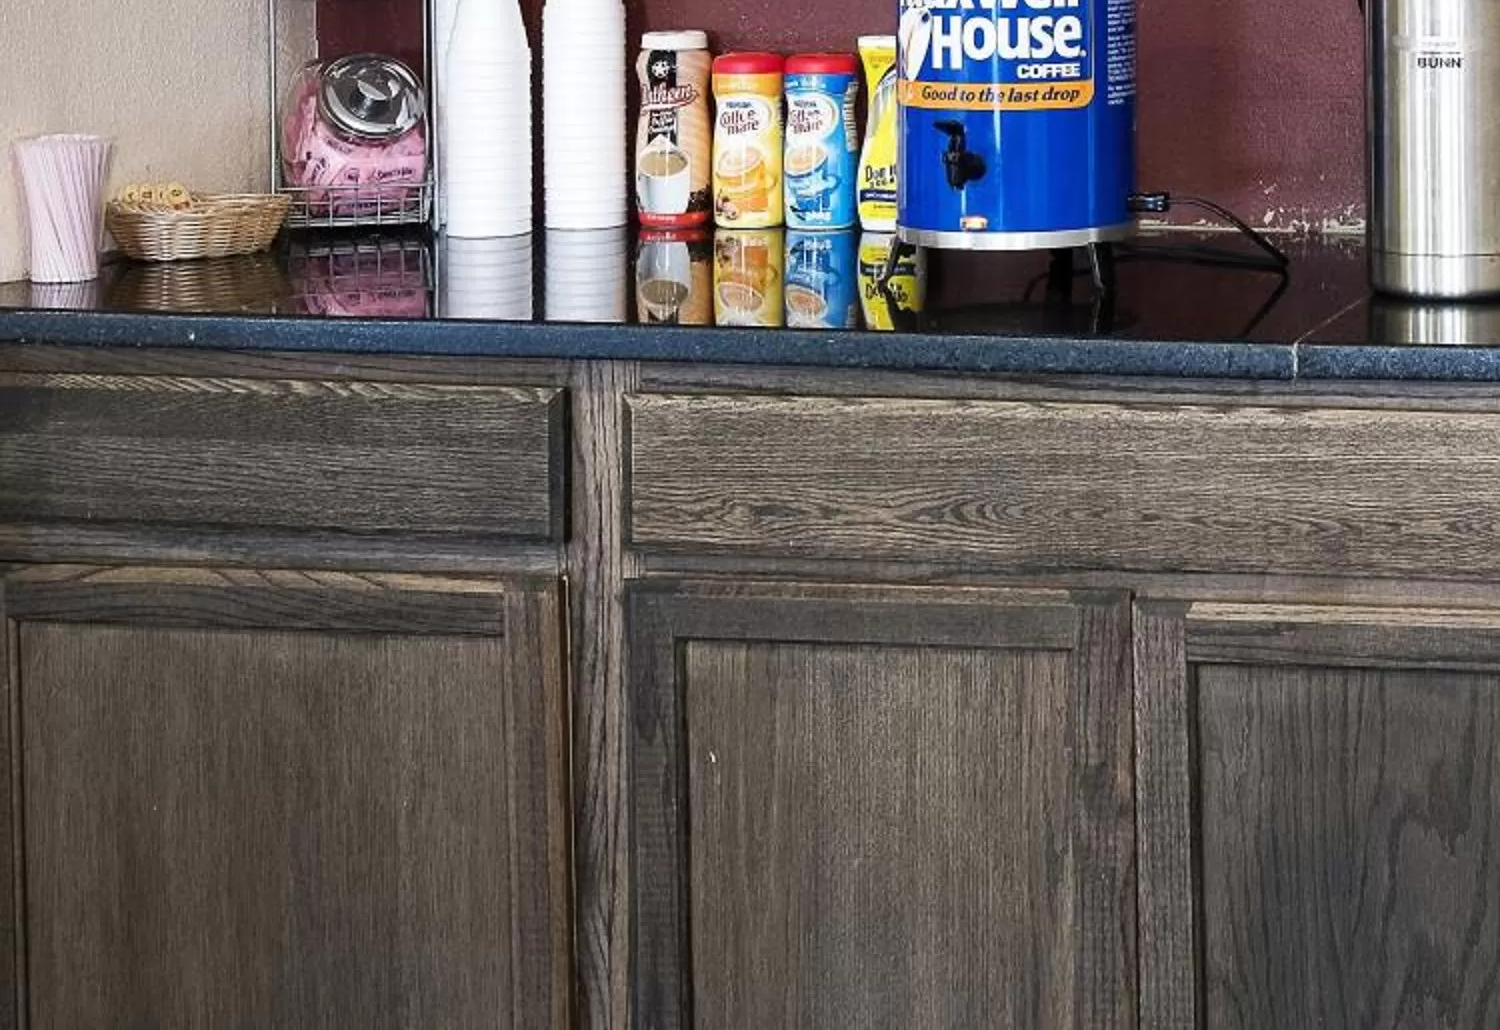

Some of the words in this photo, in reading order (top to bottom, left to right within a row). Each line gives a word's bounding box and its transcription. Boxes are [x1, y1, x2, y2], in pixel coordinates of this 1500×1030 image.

[1016, 62, 1081, 79] COFFEE
[1417, 57, 1462, 69] BUNN
[921, 85, 957, 102] Good
[959, 89, 976, 102] to
[978, 87, 1005, 103] the
[1007, 87, 1039, 103] last
[1041, 86, 1081, 103] drop
